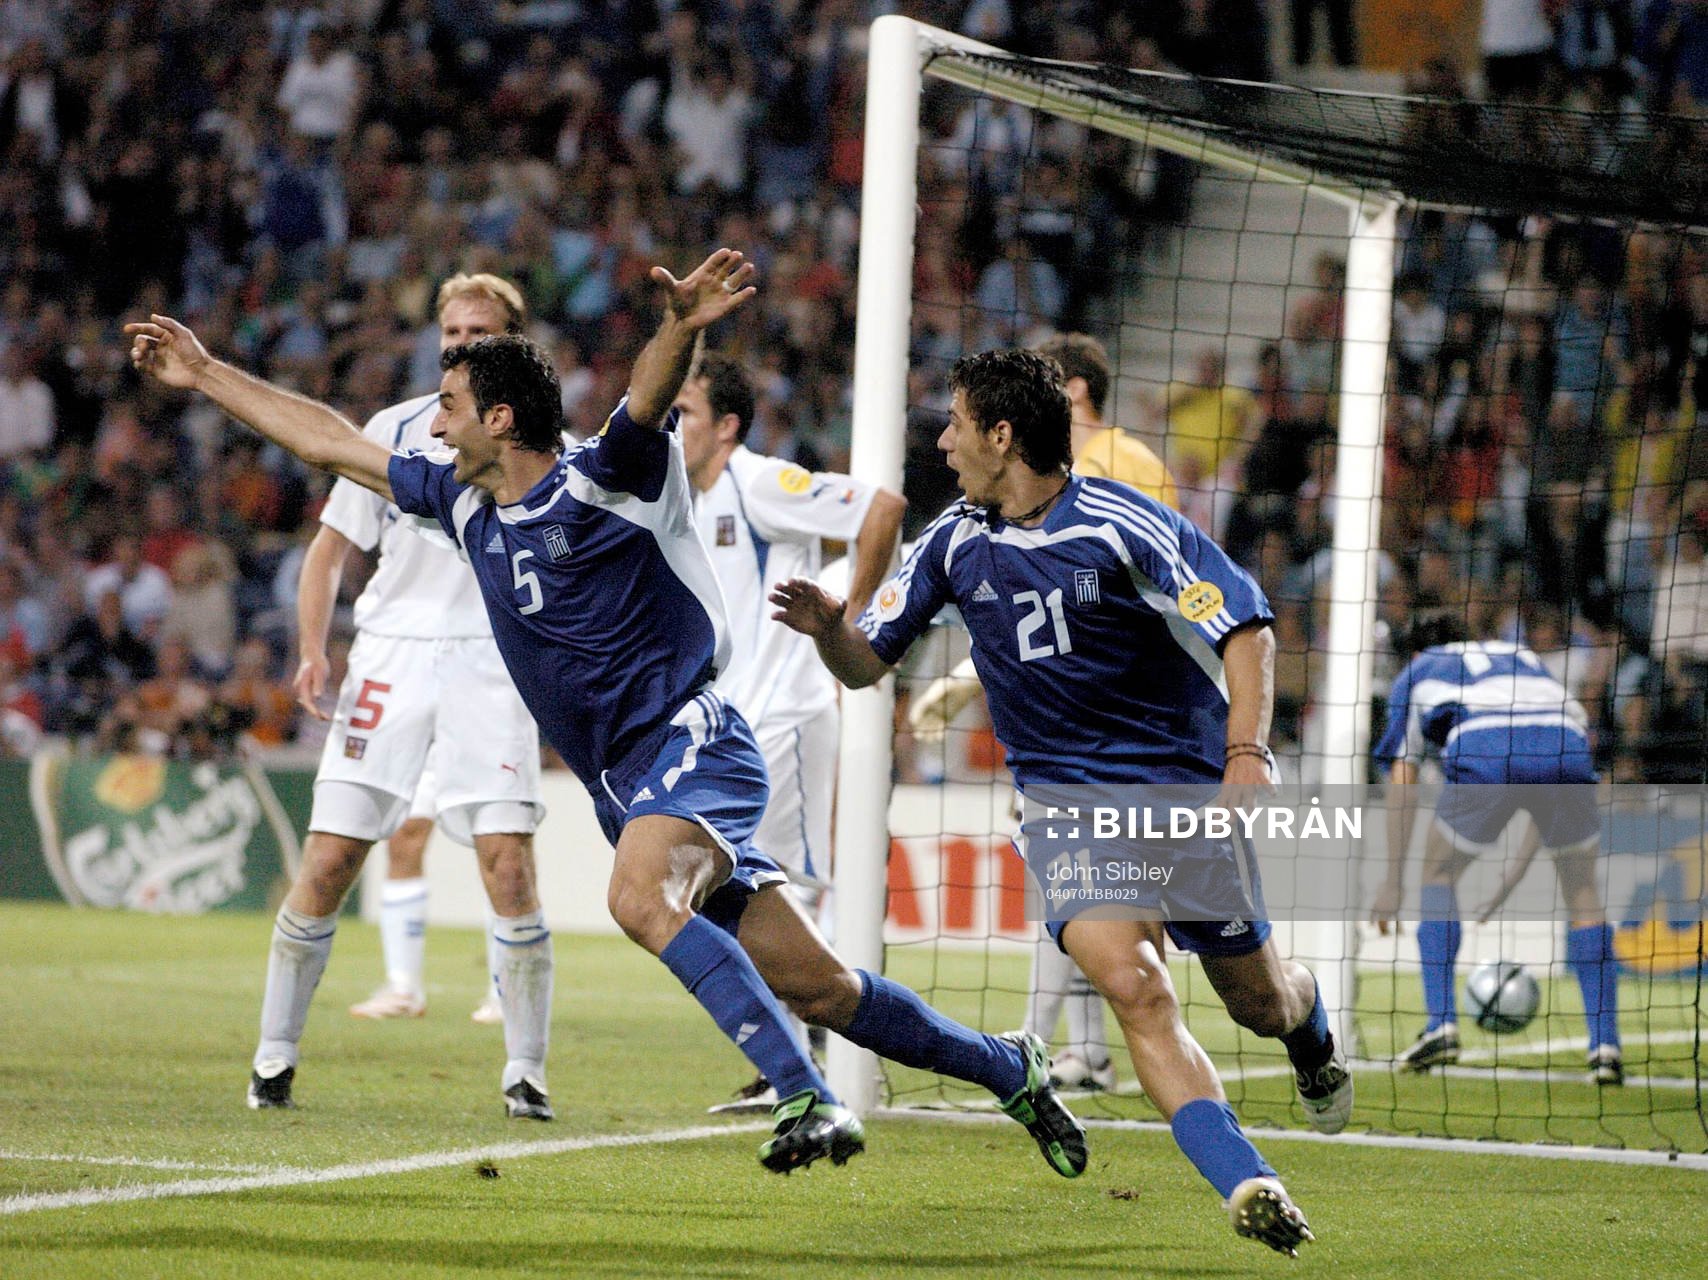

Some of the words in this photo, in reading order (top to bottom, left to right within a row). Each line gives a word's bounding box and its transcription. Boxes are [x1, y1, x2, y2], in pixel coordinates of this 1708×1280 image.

[512, 549, 544, 616] 5
[1012, 588, 1072, 663] 21
[350, 679, 391, 731] 5
